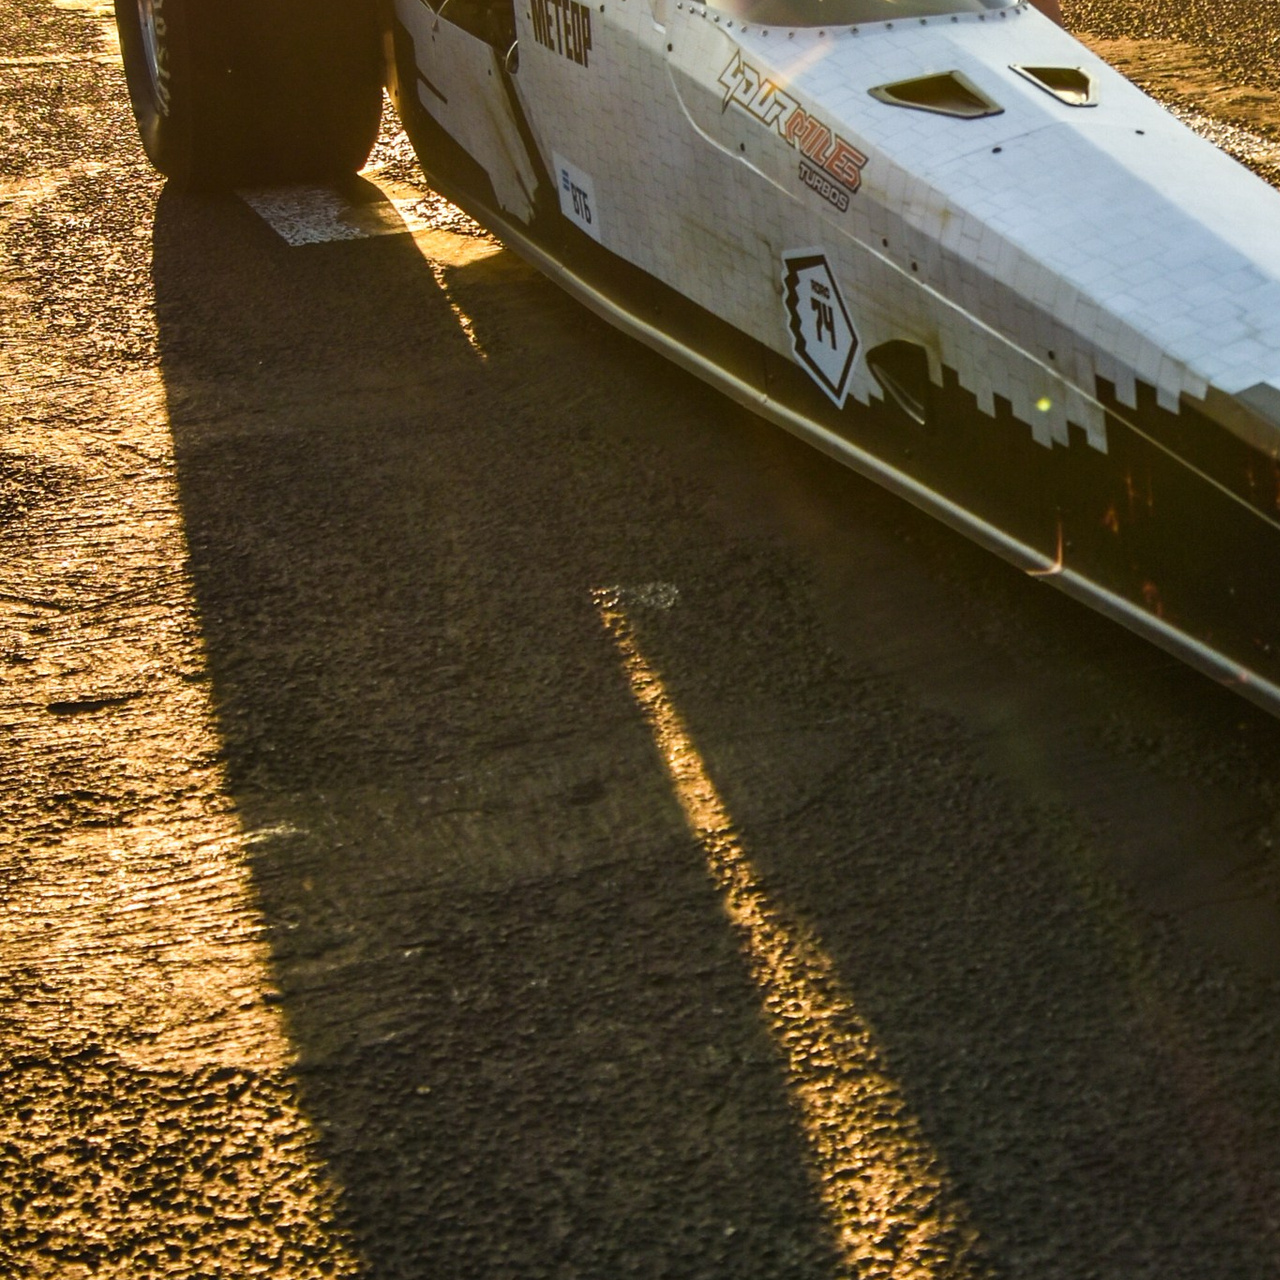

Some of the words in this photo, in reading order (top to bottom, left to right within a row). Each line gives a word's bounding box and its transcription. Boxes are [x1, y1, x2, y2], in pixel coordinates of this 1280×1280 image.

[570, 181, 592, 224] ВТБ
[798, 161, 850, 213] TURBOS
[810, 296, 838, 351] 74
